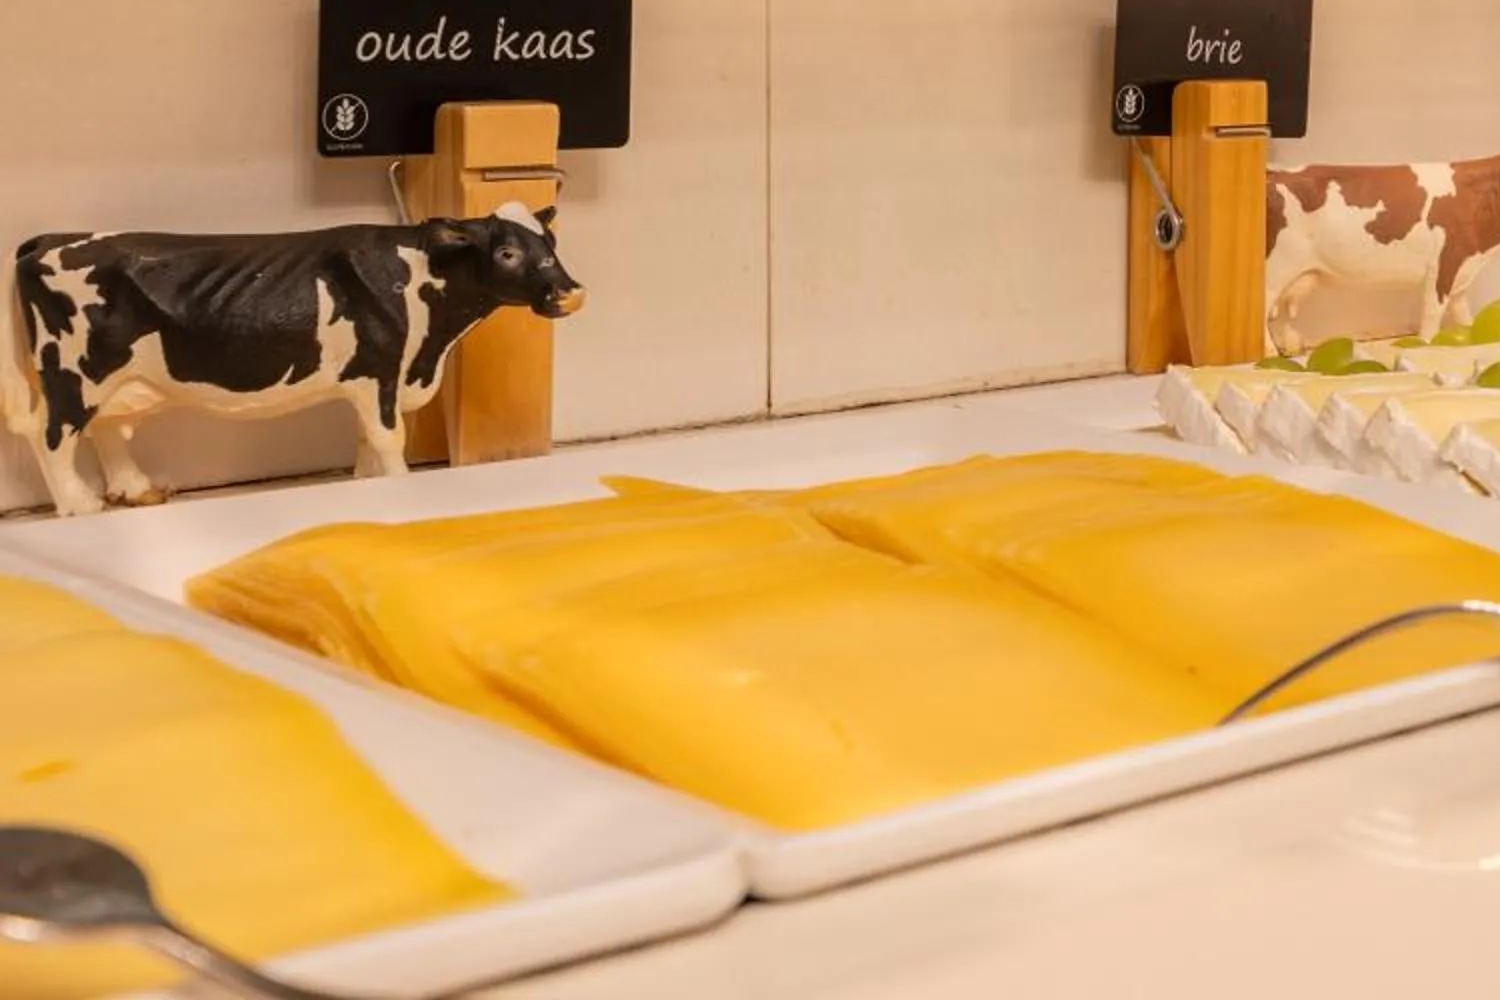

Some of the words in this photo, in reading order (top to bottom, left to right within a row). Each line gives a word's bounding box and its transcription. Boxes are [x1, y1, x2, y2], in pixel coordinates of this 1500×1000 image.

[355, 16, 472, 62] oude
[493, 16, 596, 61] kaas
[1186, 24, 1243, 65] brie
